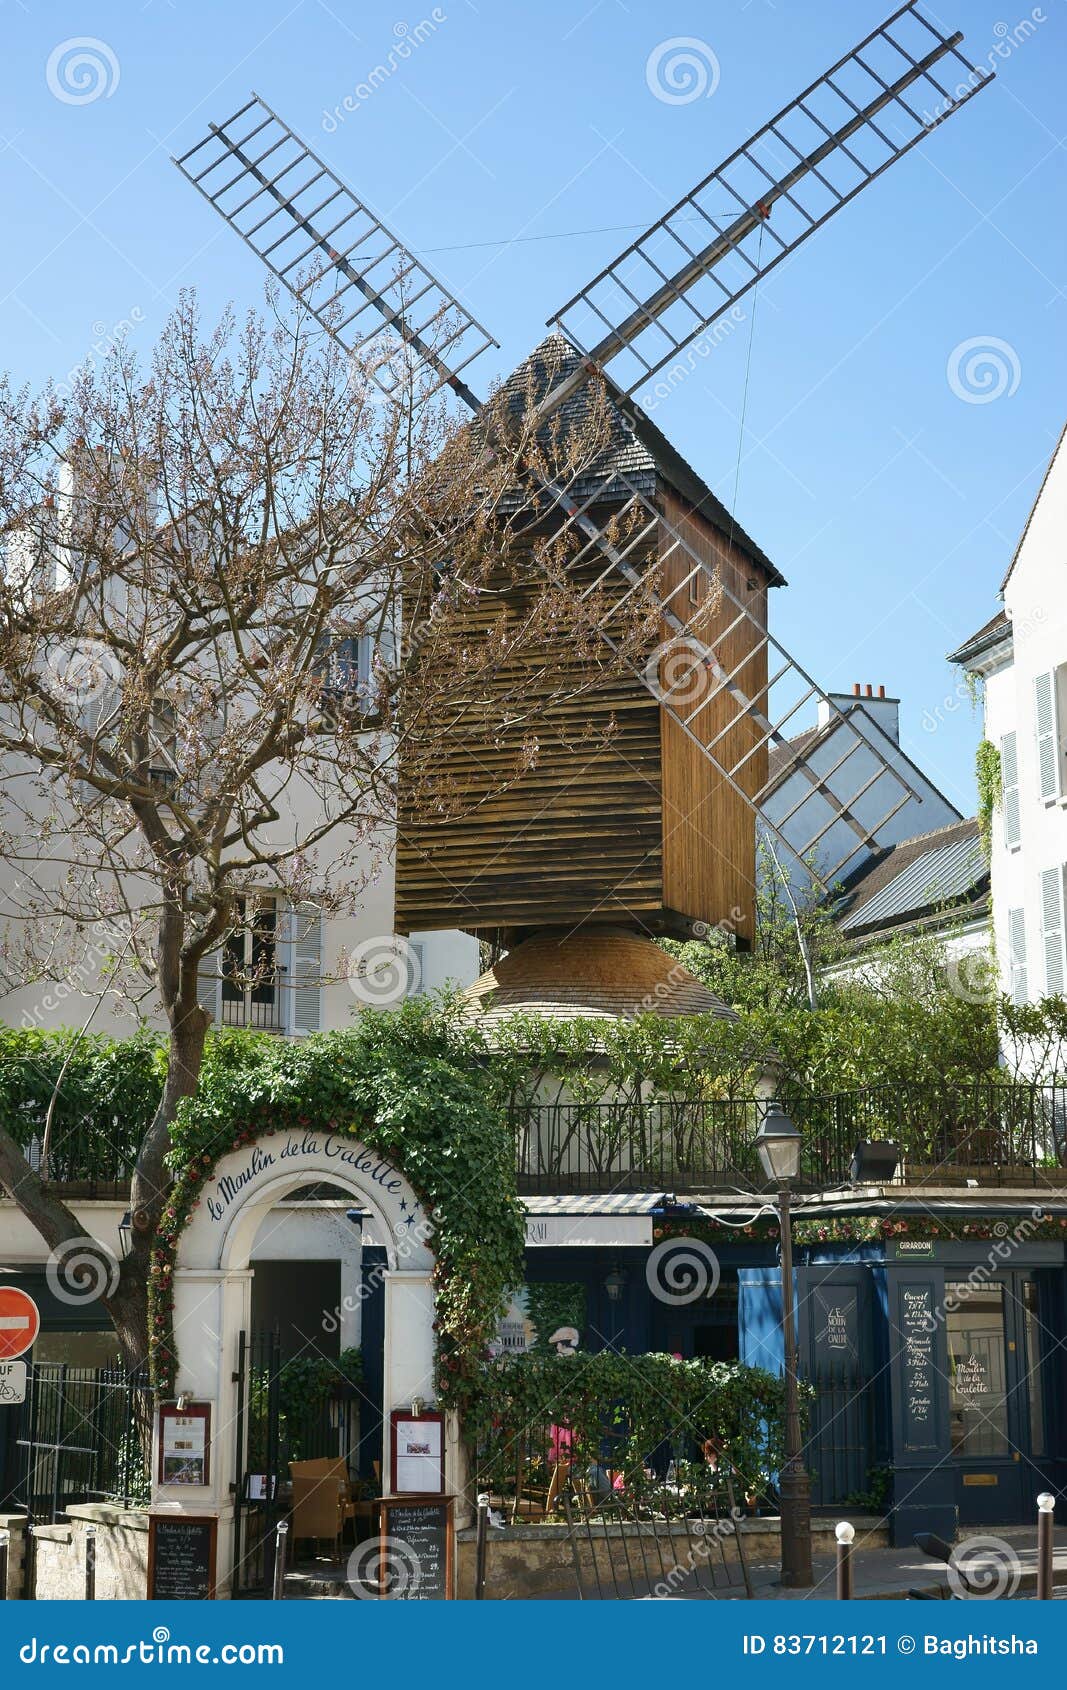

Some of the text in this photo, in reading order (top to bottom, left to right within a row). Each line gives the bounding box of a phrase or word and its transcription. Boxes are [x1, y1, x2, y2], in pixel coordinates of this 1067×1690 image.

[217, 1147, 276, 1205] Moulin
[324, 1135, 402, 1194] Galette
[899, 1241, 931, 1250] GIRARDON
[956, 1363, 986, 1373] Moulin
[956, 1383, 988, 1394] Galette
